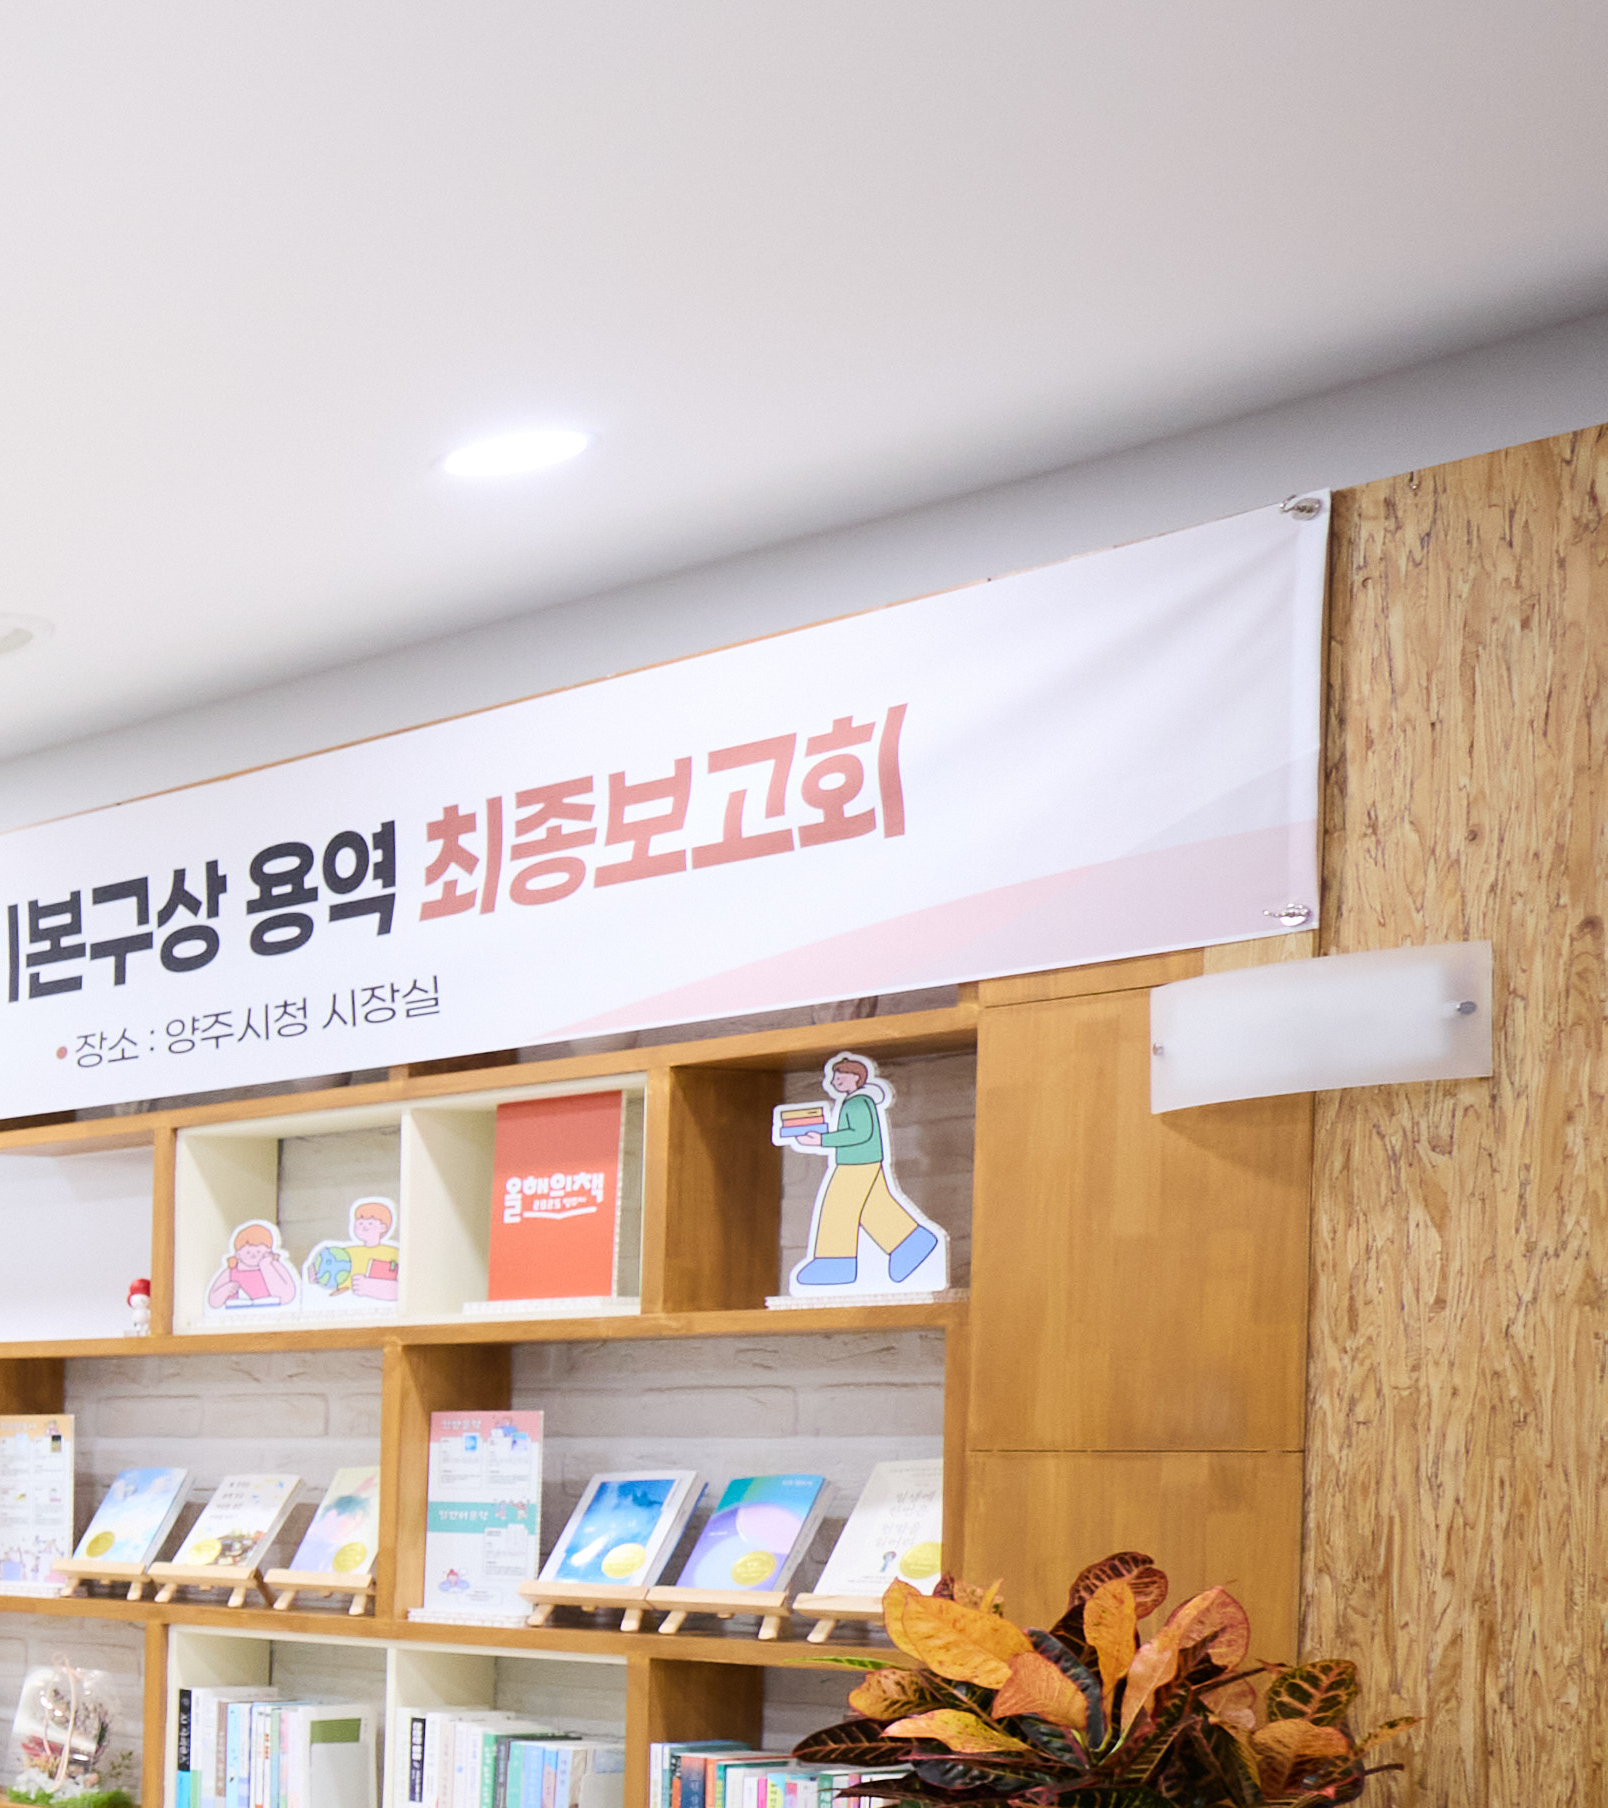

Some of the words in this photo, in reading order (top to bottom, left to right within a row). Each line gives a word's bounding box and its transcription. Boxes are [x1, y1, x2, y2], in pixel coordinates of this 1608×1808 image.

[245, 819, 397, 957] 용역
[419, 702, 909, 922] 최종보고회
[164, 997, 309, 1055] 양주시청
[321, 974, 442, 1031] 시장실
